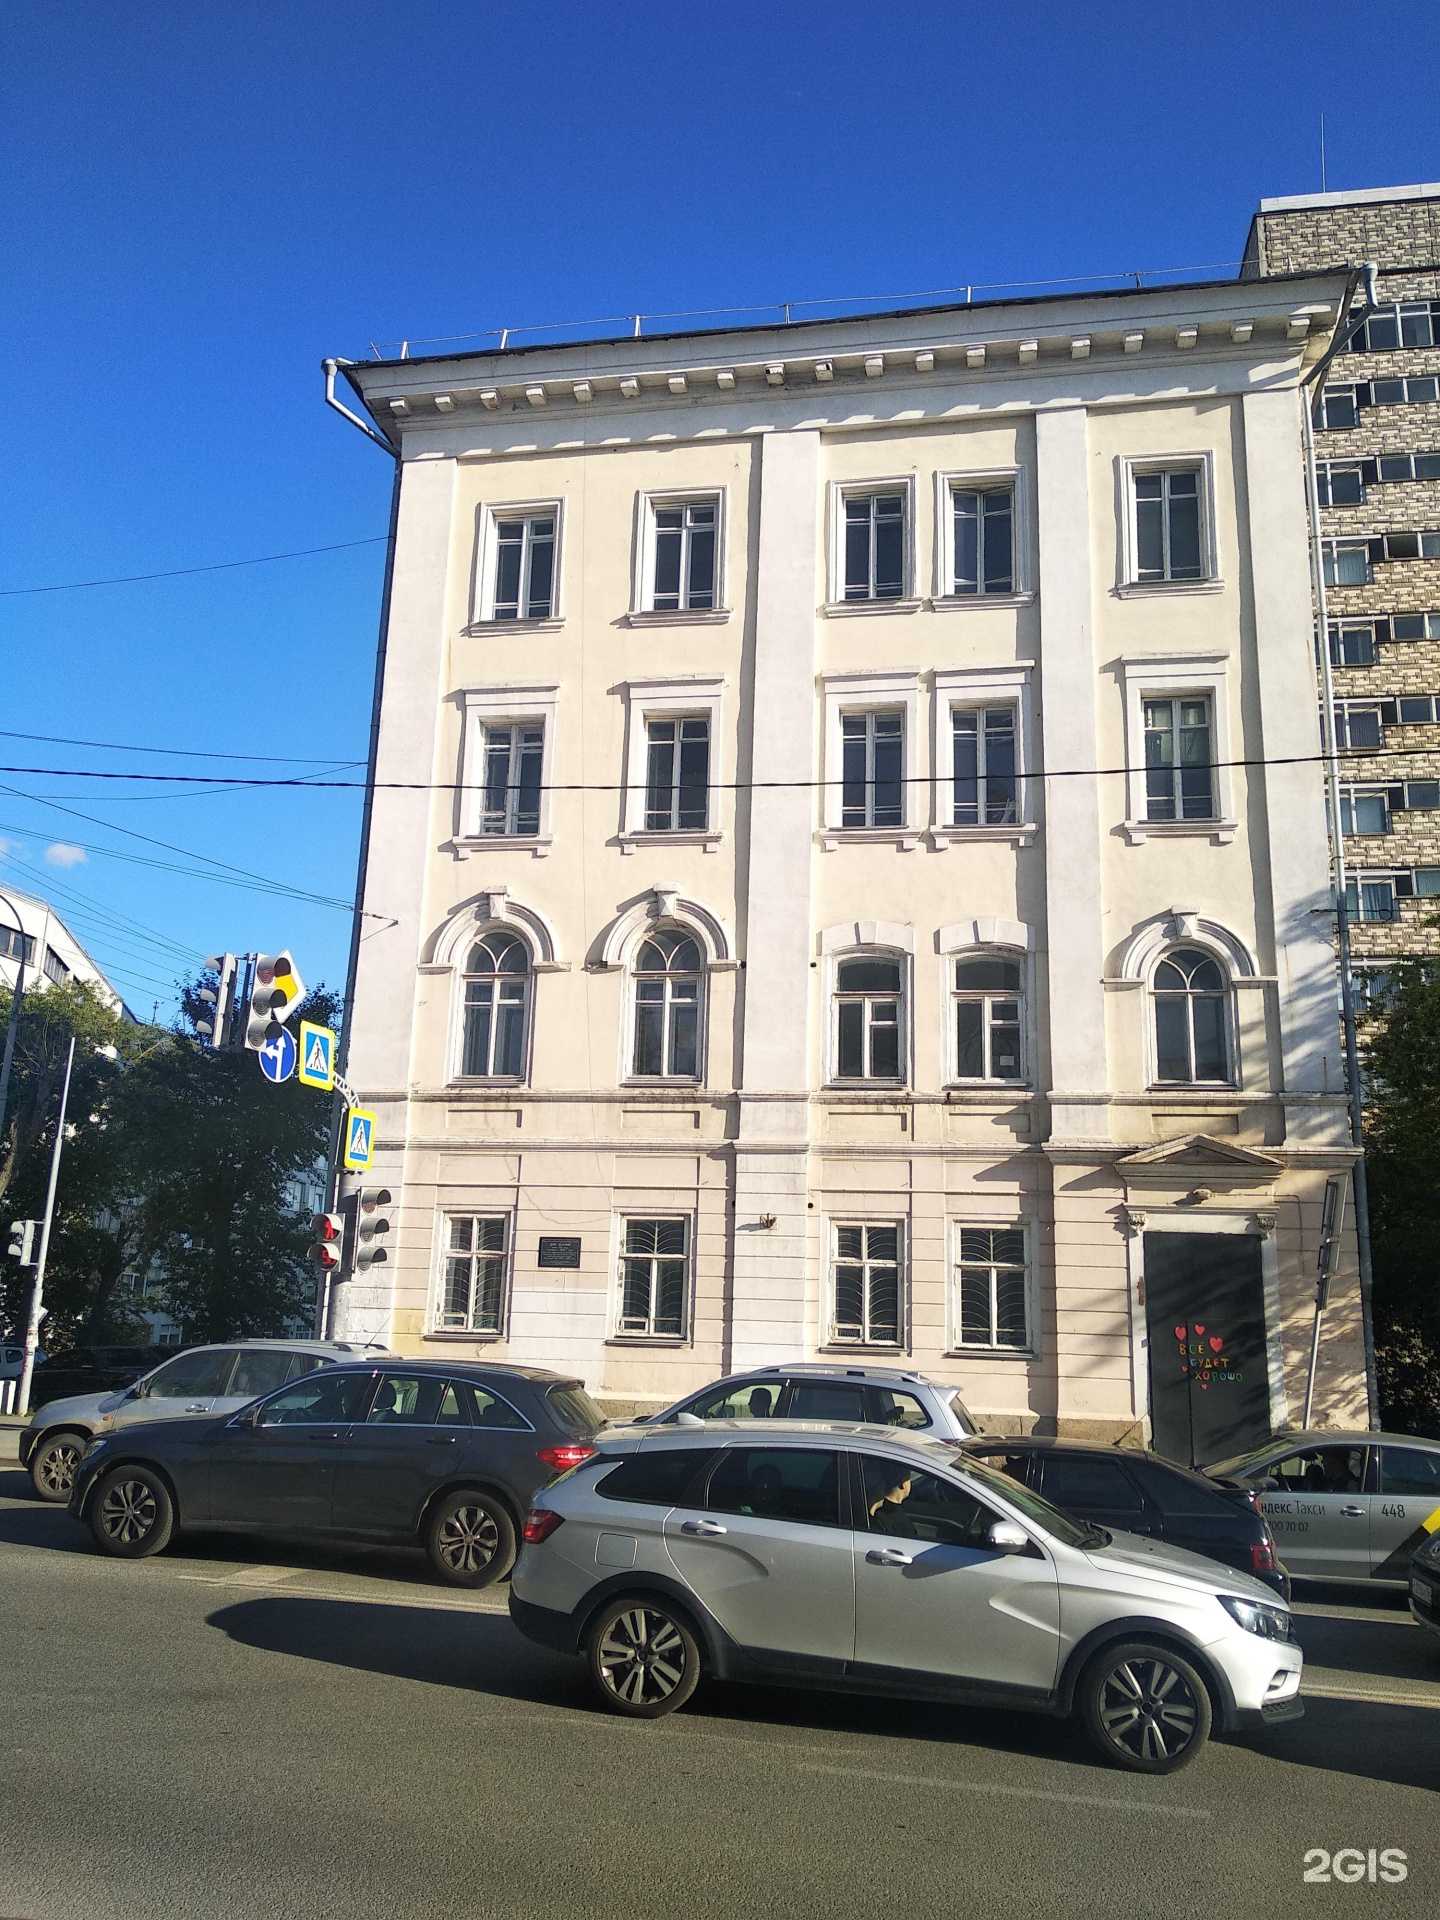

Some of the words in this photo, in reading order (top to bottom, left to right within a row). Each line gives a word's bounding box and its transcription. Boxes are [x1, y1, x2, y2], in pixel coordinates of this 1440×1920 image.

[1179, 1344, 1205, 1355] ВСЕ
[1190, 1358, 1230, 1369] БУДЕТ
[1261, 1503, 1292, 1514] ндекс
[1295, 1500, 1326, 1515] Такси
[1382, 1503, 1406, 1518] 448
